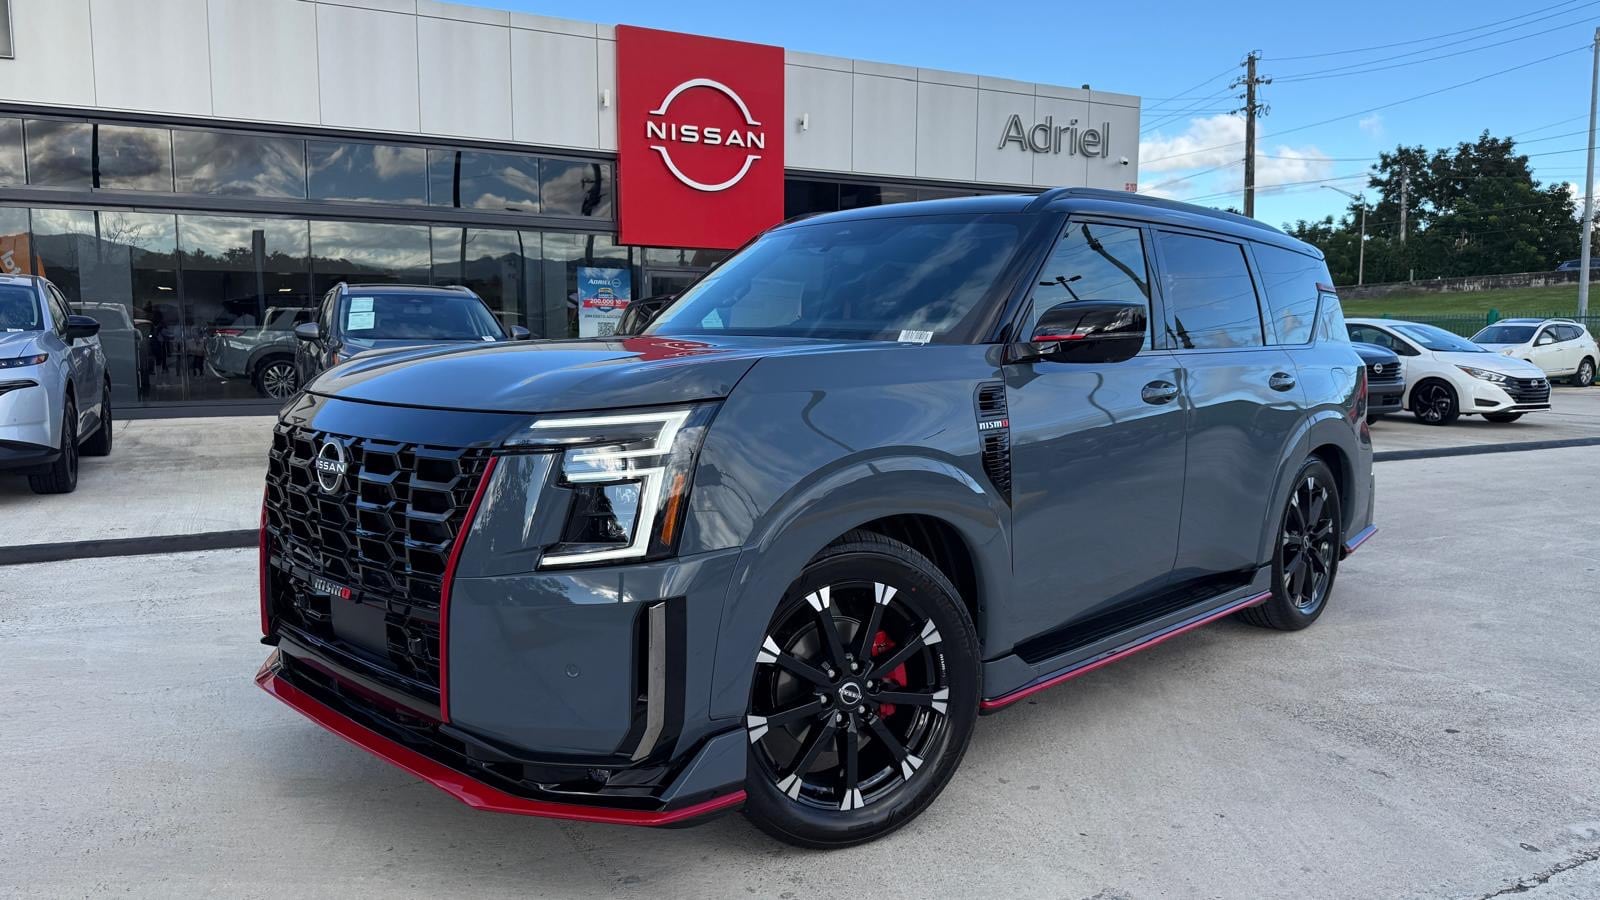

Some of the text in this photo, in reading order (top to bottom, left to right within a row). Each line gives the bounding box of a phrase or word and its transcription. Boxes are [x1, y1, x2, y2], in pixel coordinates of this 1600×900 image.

[646, 120, 765, 149] NISSAN
[998, 114, 1110, 158] Adriel
[318, 460, 345, 473] SSAN
